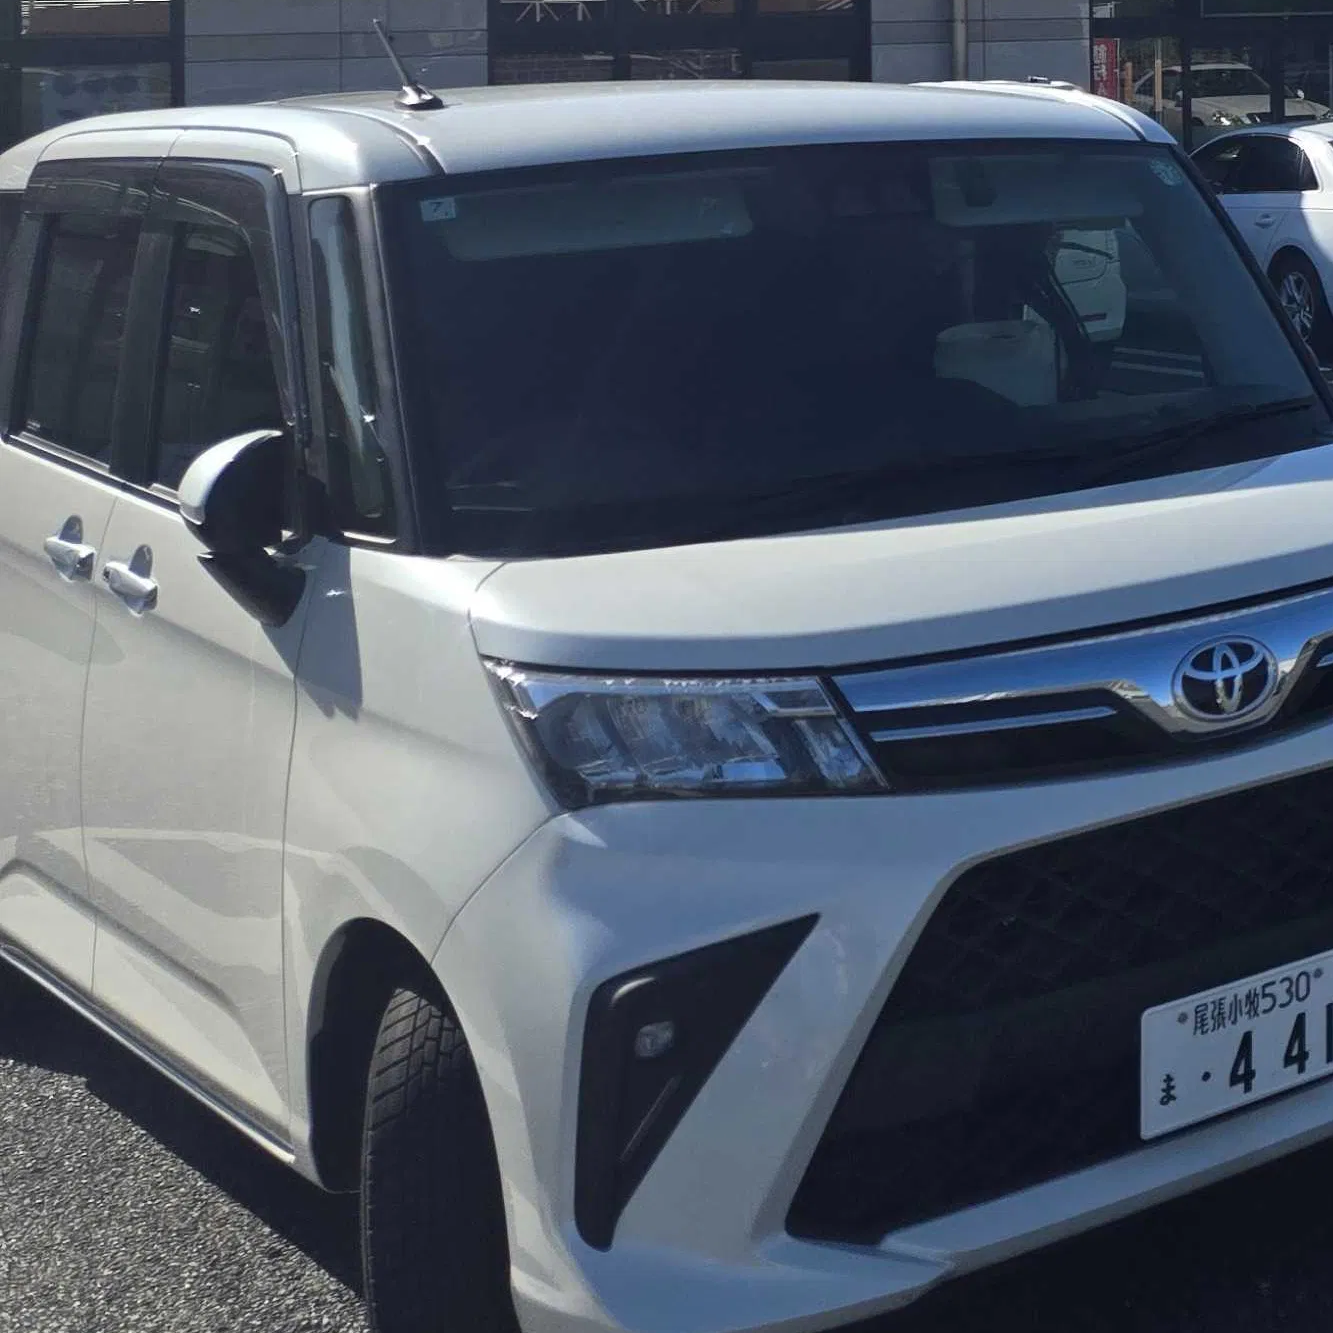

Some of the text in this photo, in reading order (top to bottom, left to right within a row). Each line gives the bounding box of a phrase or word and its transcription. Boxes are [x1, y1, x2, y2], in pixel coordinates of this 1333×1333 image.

[1193, 971, 1311, 1036] 尾張小牧530
[1159, 1074, 1177, 1106] ま
